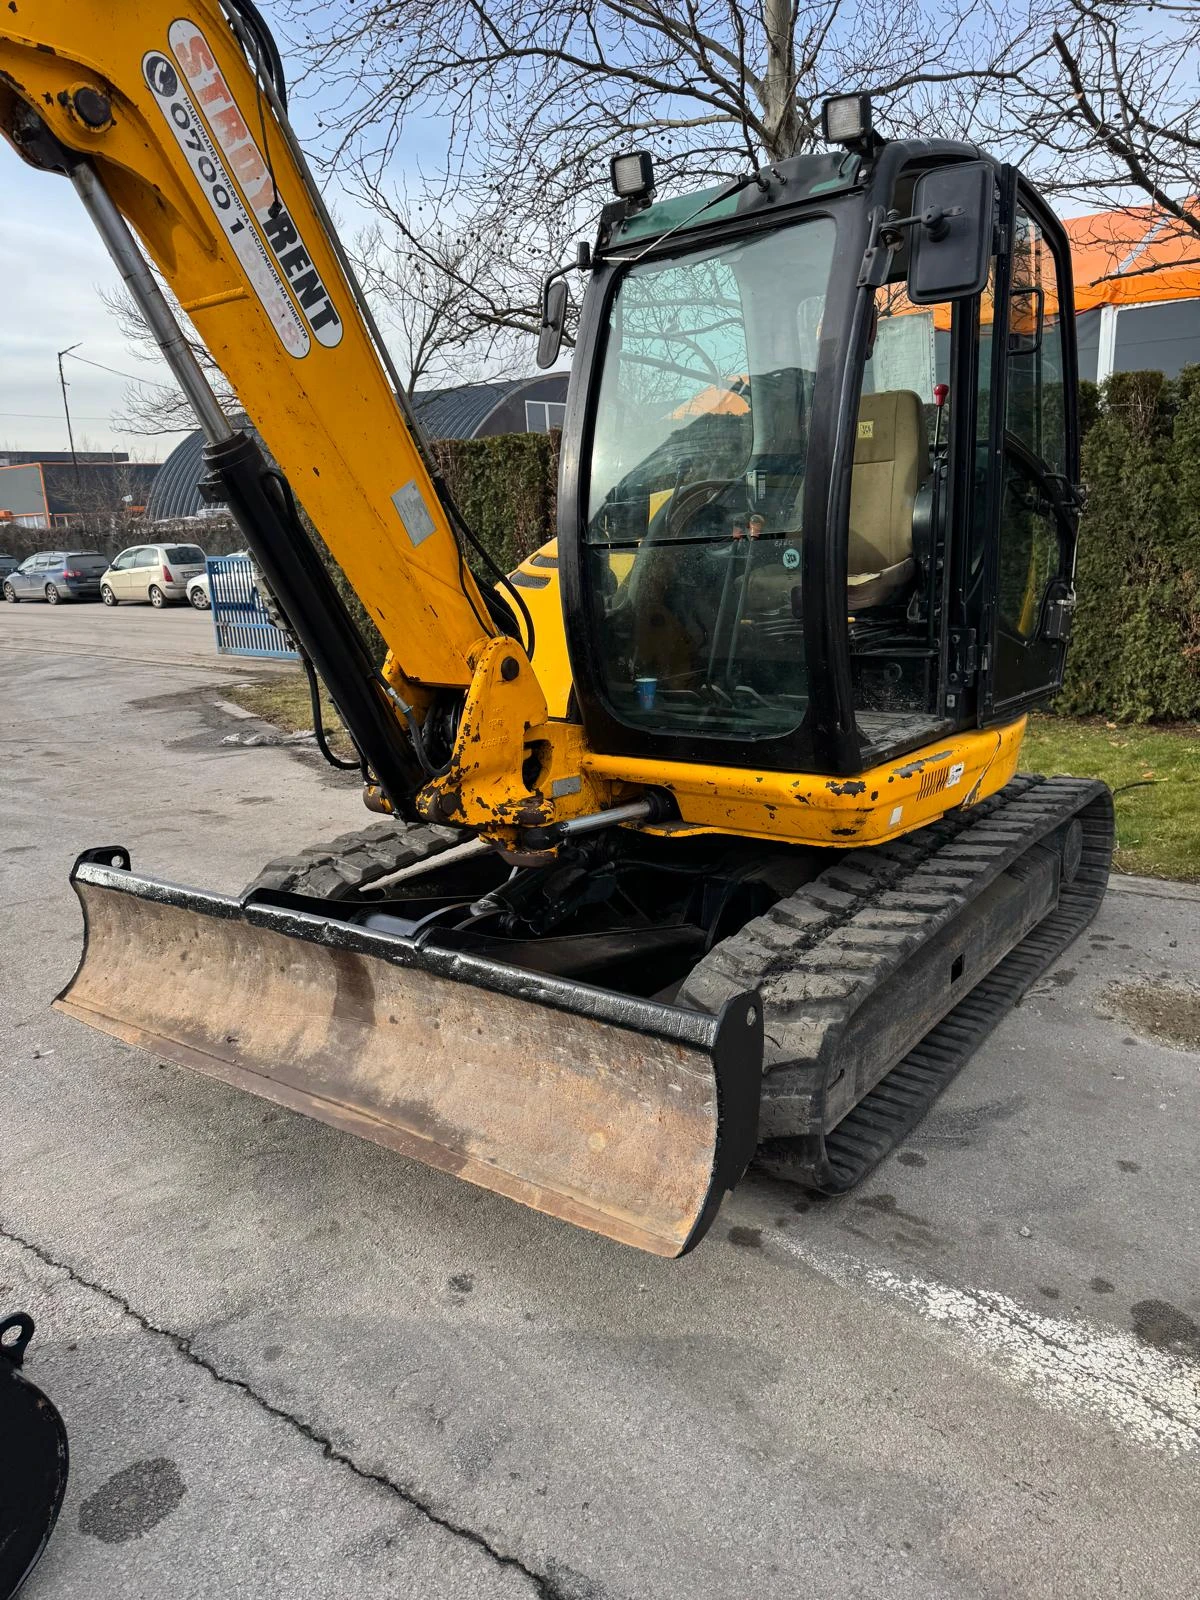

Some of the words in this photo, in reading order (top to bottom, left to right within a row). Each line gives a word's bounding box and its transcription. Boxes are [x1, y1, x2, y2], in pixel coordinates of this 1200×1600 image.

[170, 101, 232, 211] 0700
[228, 217, 244, 235] 1
[183, 96, 219, 166] НАЦИОНАЛЕН
[218, 165, 243, 211] ТЕЛЕФОН
[240, 211, 251, 225] ЗА
[248, 224, 281, 286] ОБСЛУЖВАНЕ
[278, 286, 289, 300] НА
[286, 299, 308, 339] КЛИЕНТИ
